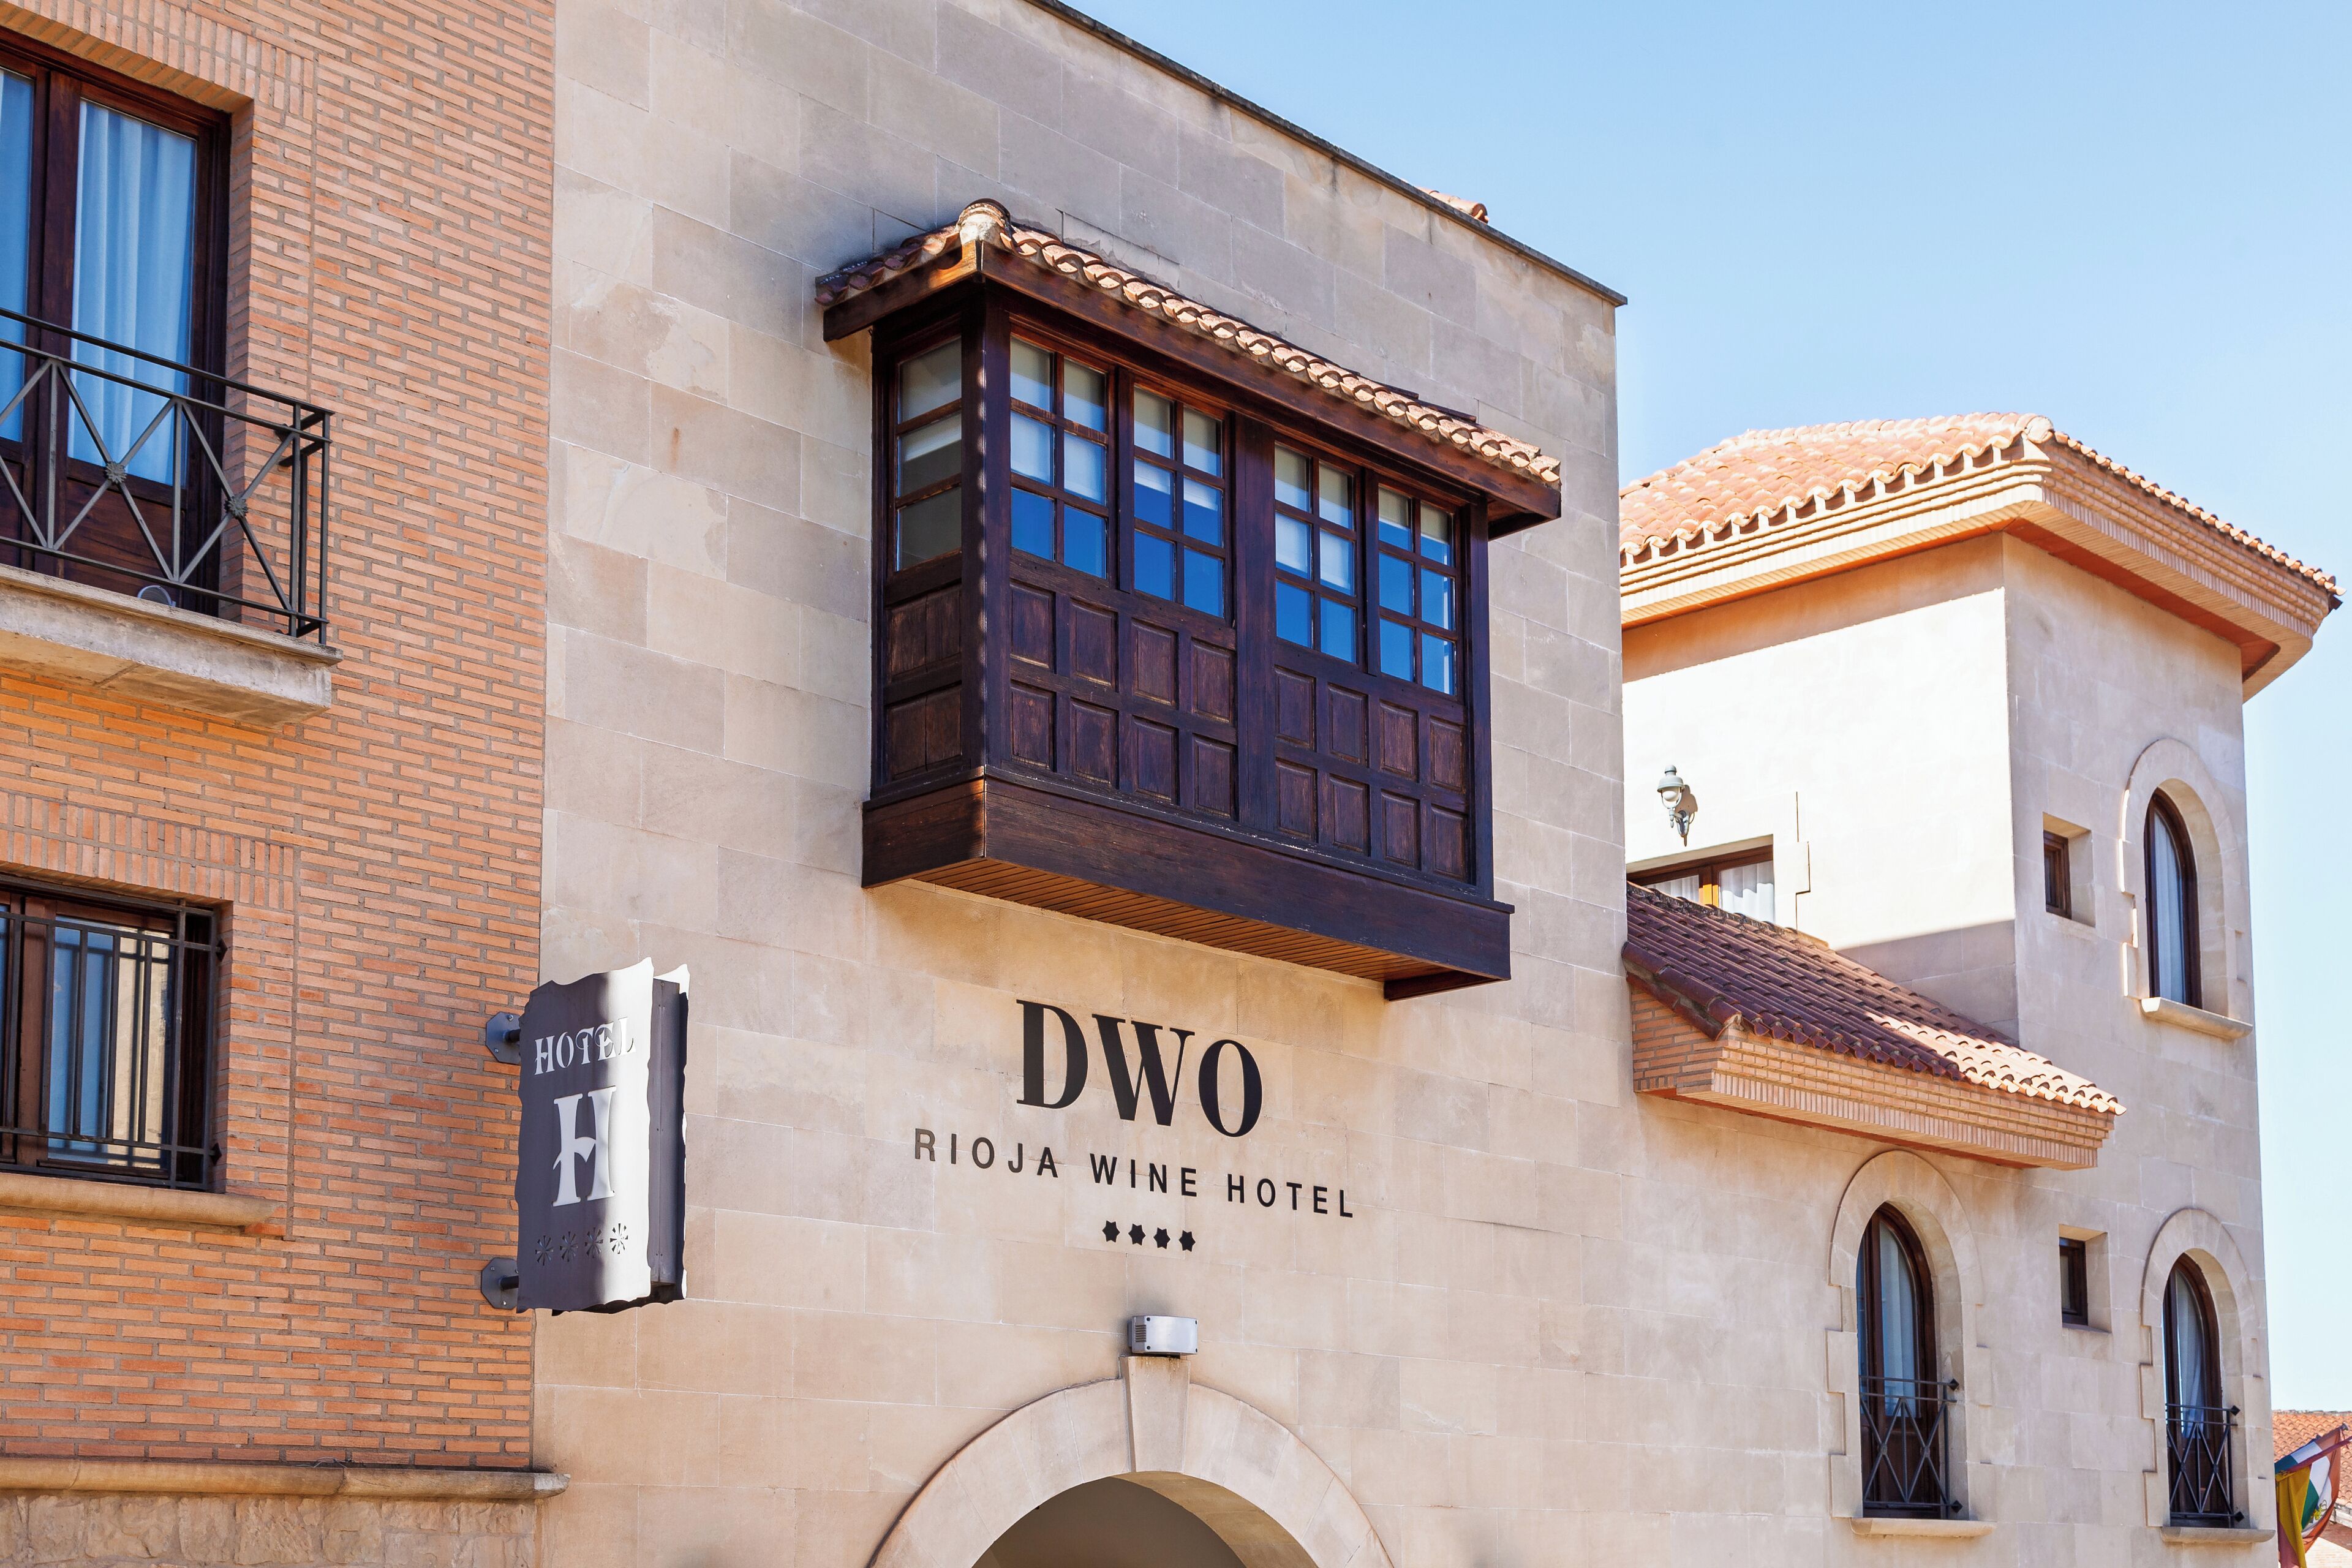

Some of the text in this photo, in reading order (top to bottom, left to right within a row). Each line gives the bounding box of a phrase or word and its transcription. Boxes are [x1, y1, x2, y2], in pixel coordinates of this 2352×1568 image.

[535, 1017, 635, 1076] HOTEL
[1016, 999, 1262, 1137] DWO
[552, 1085, 616, 1207] H
[914, 1128, 1353, 1218] RIOJA WINE HOTEL
